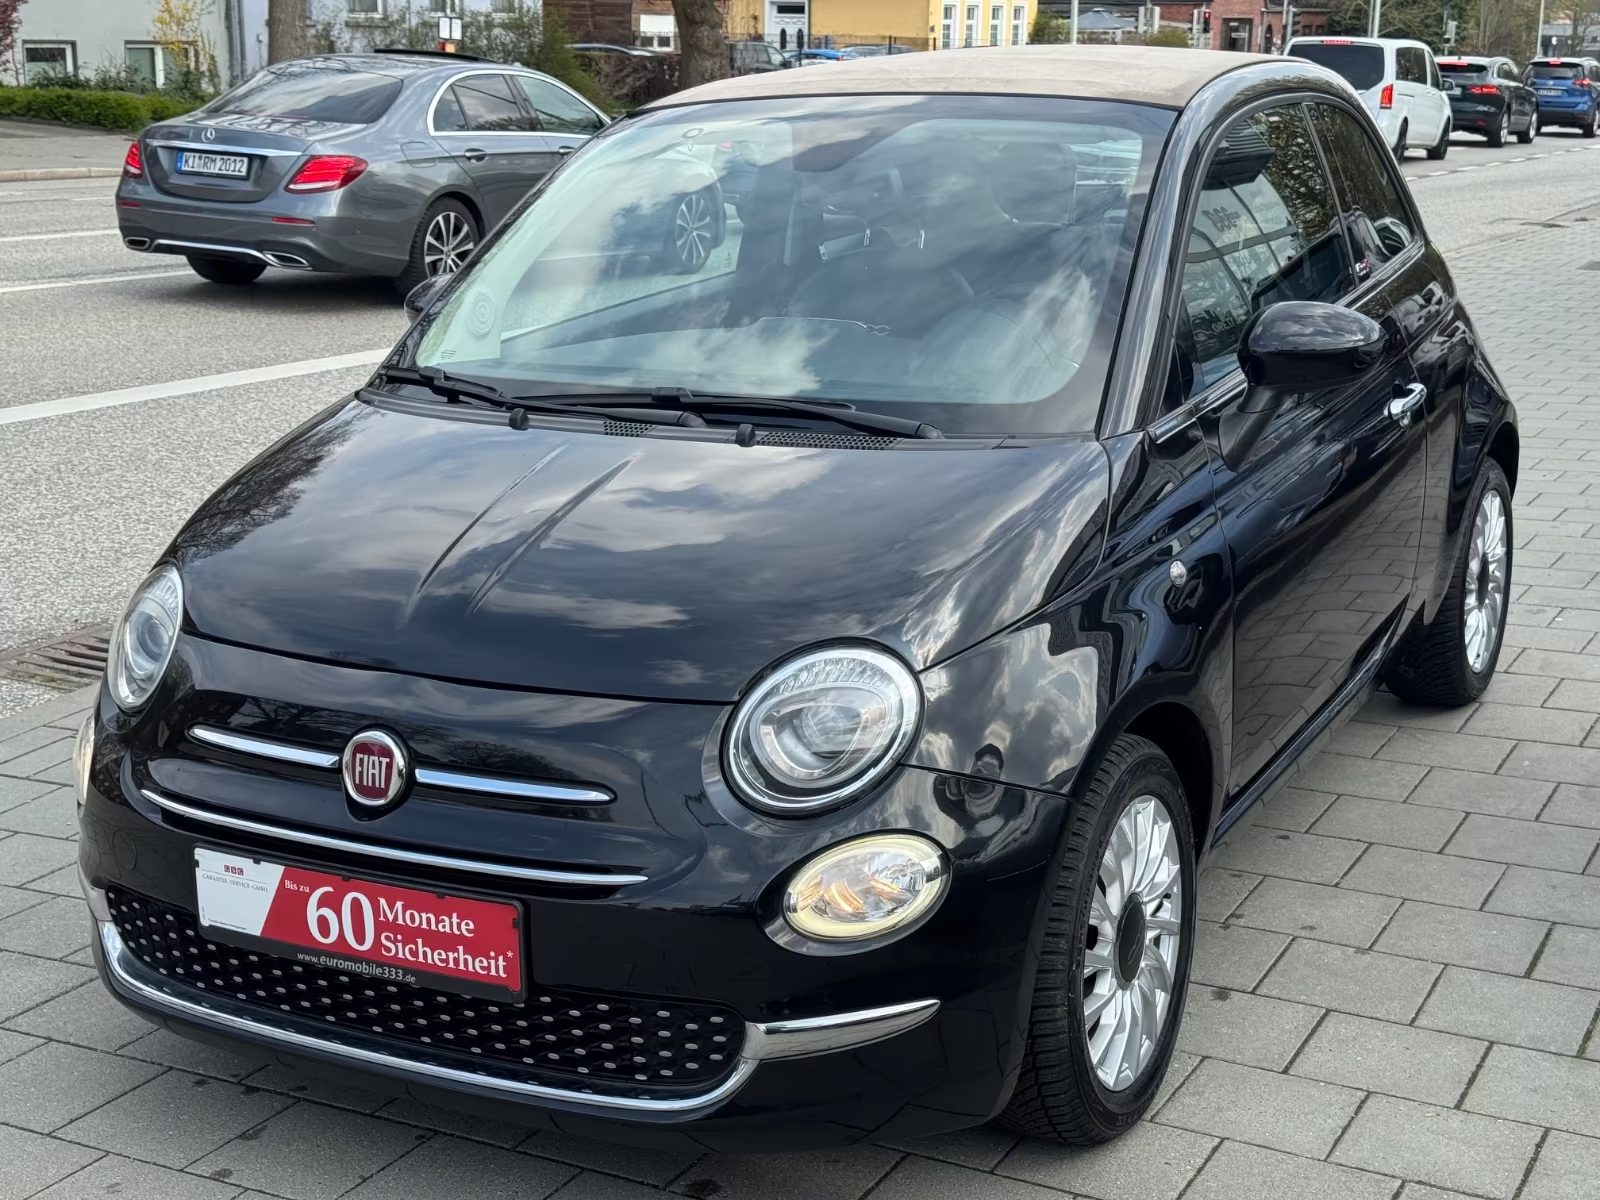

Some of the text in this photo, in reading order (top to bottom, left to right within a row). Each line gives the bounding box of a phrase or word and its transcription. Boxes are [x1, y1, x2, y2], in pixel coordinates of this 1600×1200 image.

[218, 157, 245, 173] 2012
[355, 753, 390, 789] FIAT
[284, 879, 310, 893] Bis zu
[306, 886, 375, 951] 60
[377, 897, 475, 937] Monate
[296, 952, 416, 983] www.euromobile333.de
